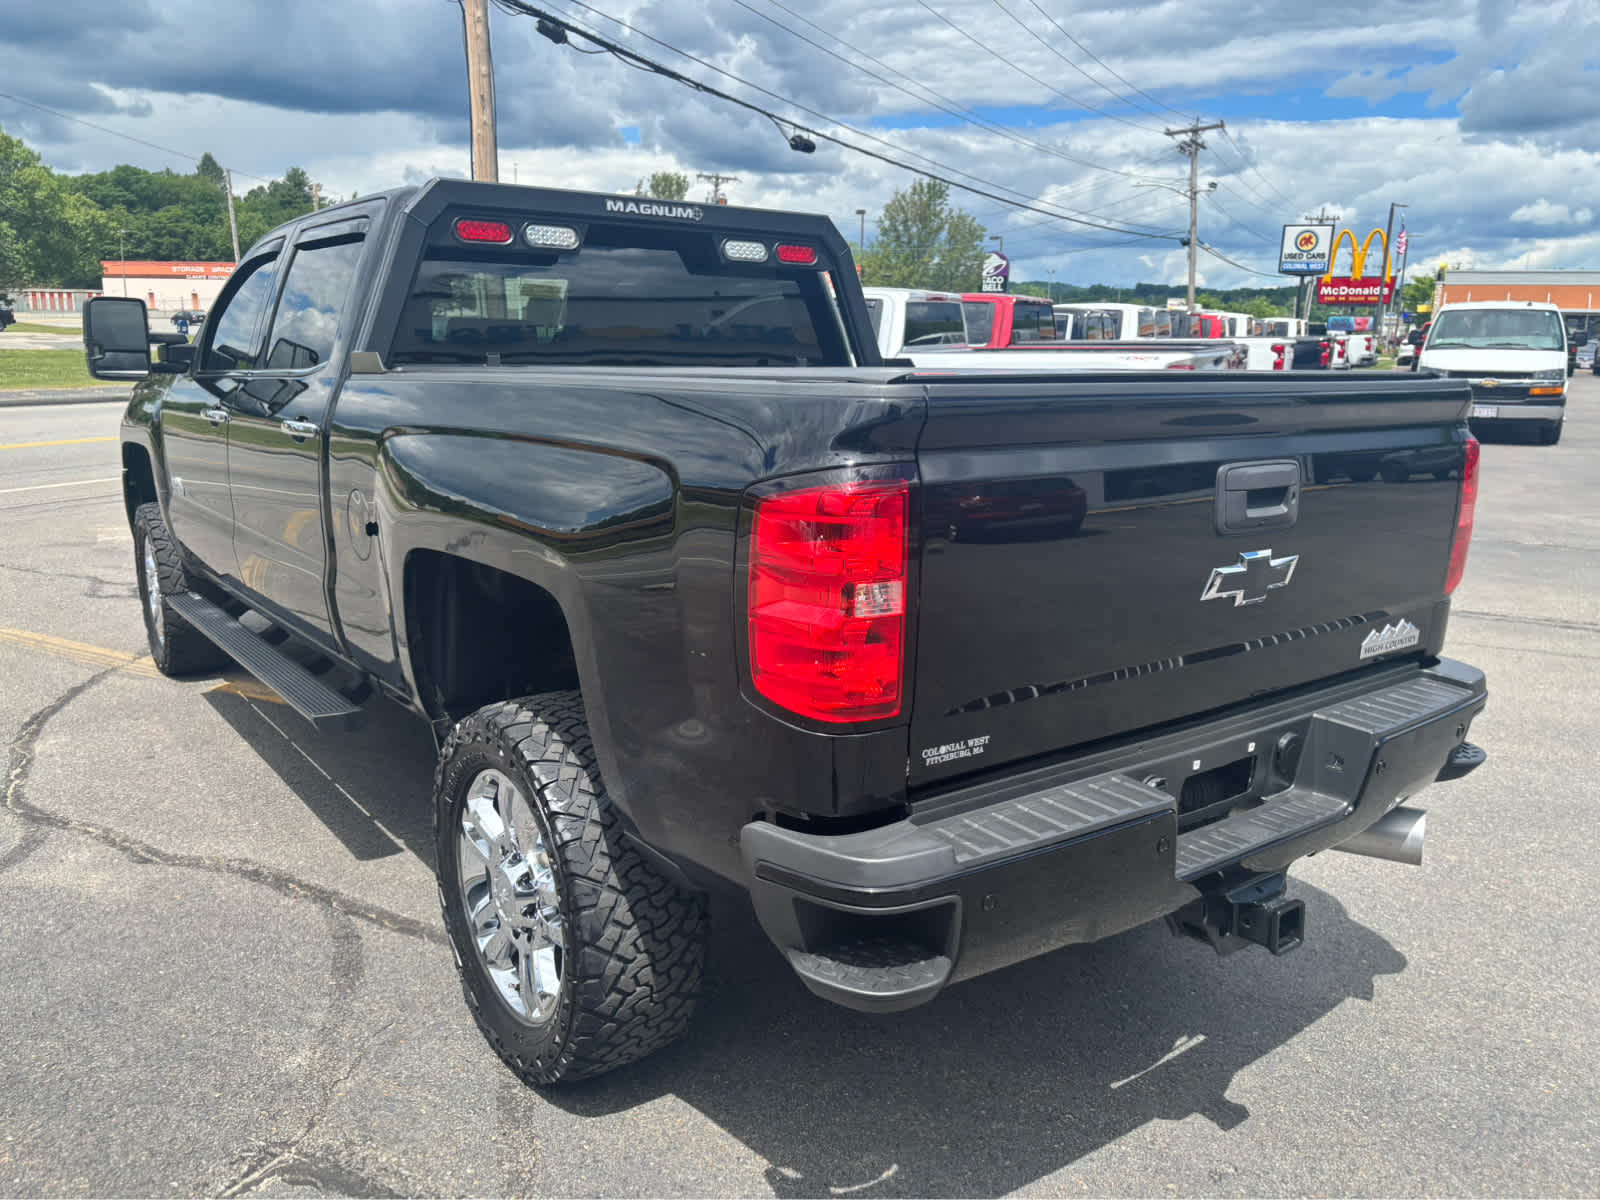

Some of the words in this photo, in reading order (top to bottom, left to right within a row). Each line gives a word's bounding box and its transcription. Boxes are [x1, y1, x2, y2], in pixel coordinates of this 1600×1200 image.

[606, 200, 693, 219] MAGNUM
[982, 276, 1004, 284] TACO
[1320, 286, 1389, 296] McDonalds
[1364, 646, 1384, 655] HIGH
[1384, 635, 1416, 649] COUNTRY
[921, 741, 966, 758] COLONIAL
[967, 735, 991, 748] WEST
[972, 746, 984, 755] MA
